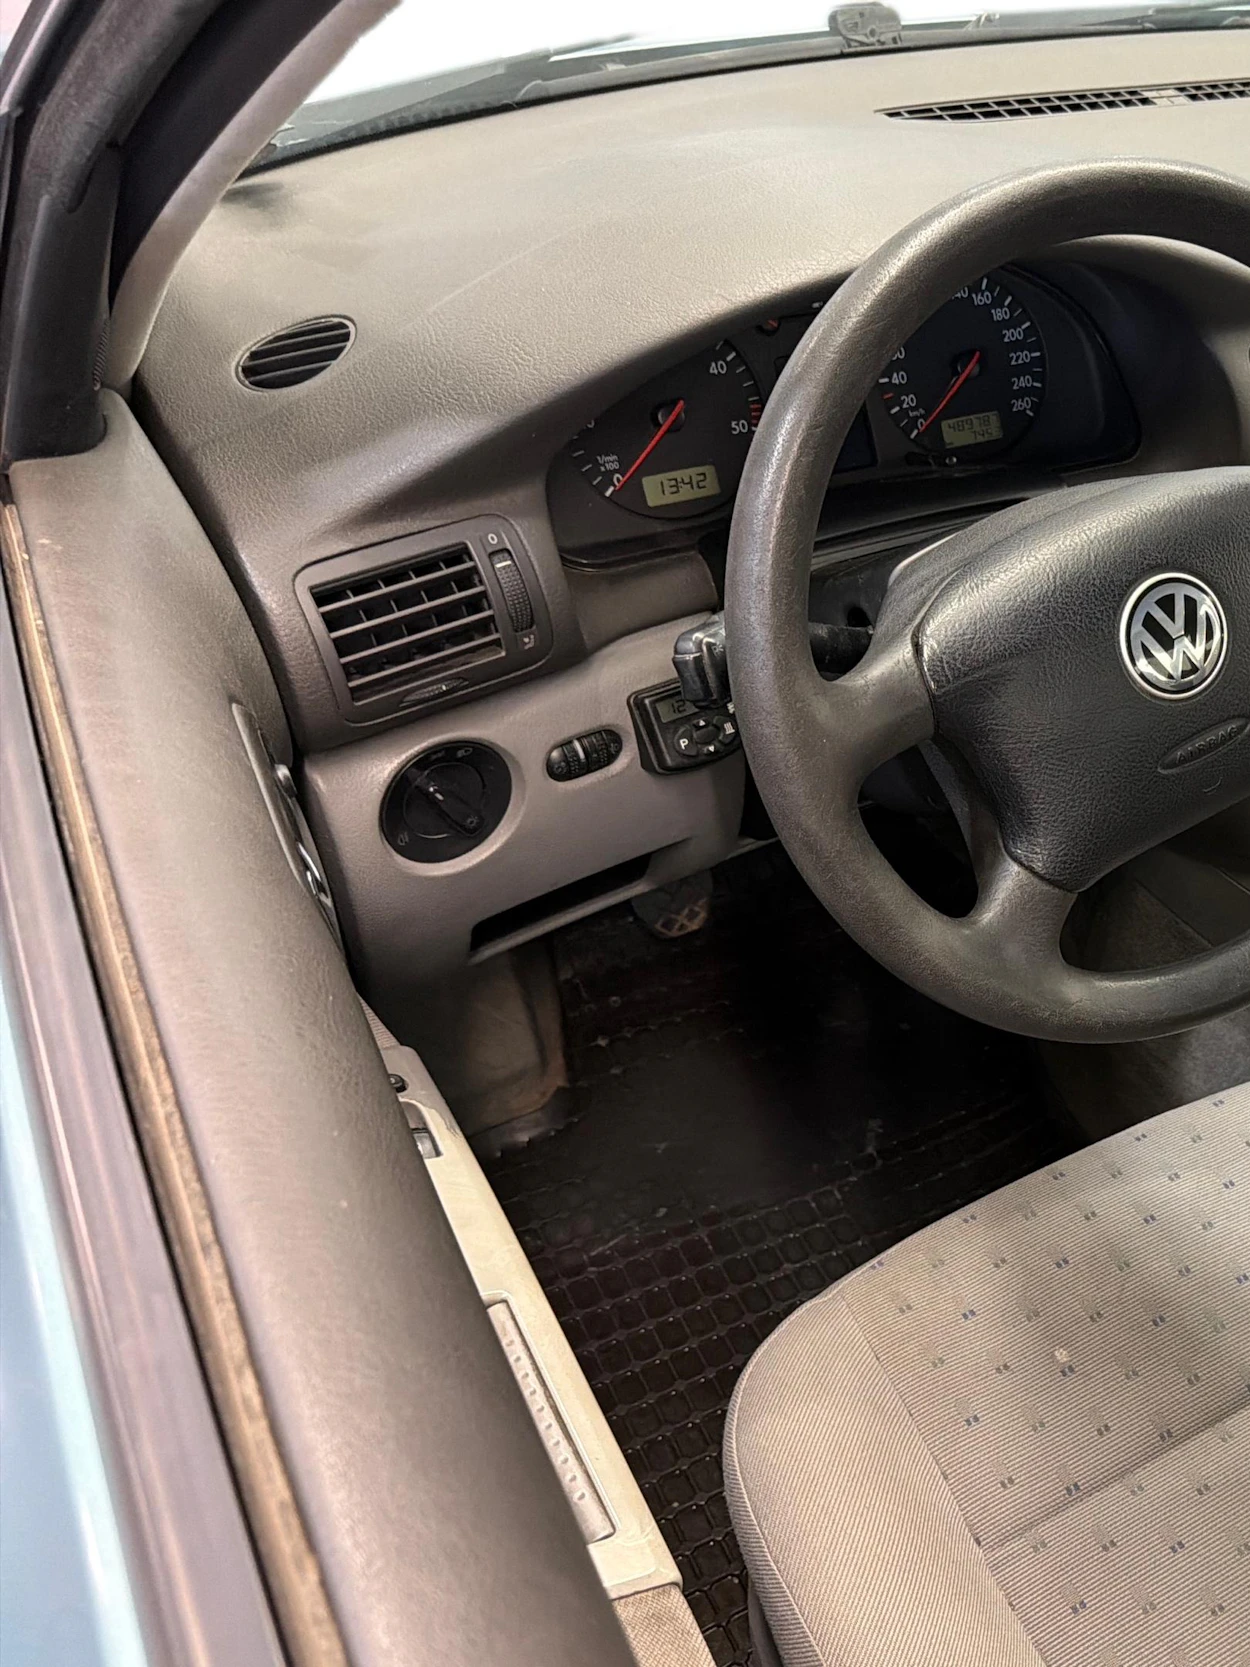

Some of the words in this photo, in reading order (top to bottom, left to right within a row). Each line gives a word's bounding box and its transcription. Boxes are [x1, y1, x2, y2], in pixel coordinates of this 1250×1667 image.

[972, 291, 992, 306] 160
[991, 307, 1010, 321] 180
[1002, 327, 1024, 342] 200
[1009, 350, 1031, 365] 220
[709, 360, 727, 375] 40
[891, 371, 908, 385] 40
[1011, 375, 1032, 390] 240
[900, 394, 917, 408] 20
[1010, 397, 1032, 412] 260
[731, 419, 749, 434] 50
[660, 472, 707, 496] 13:42
[679, 738, 689, 750] P
